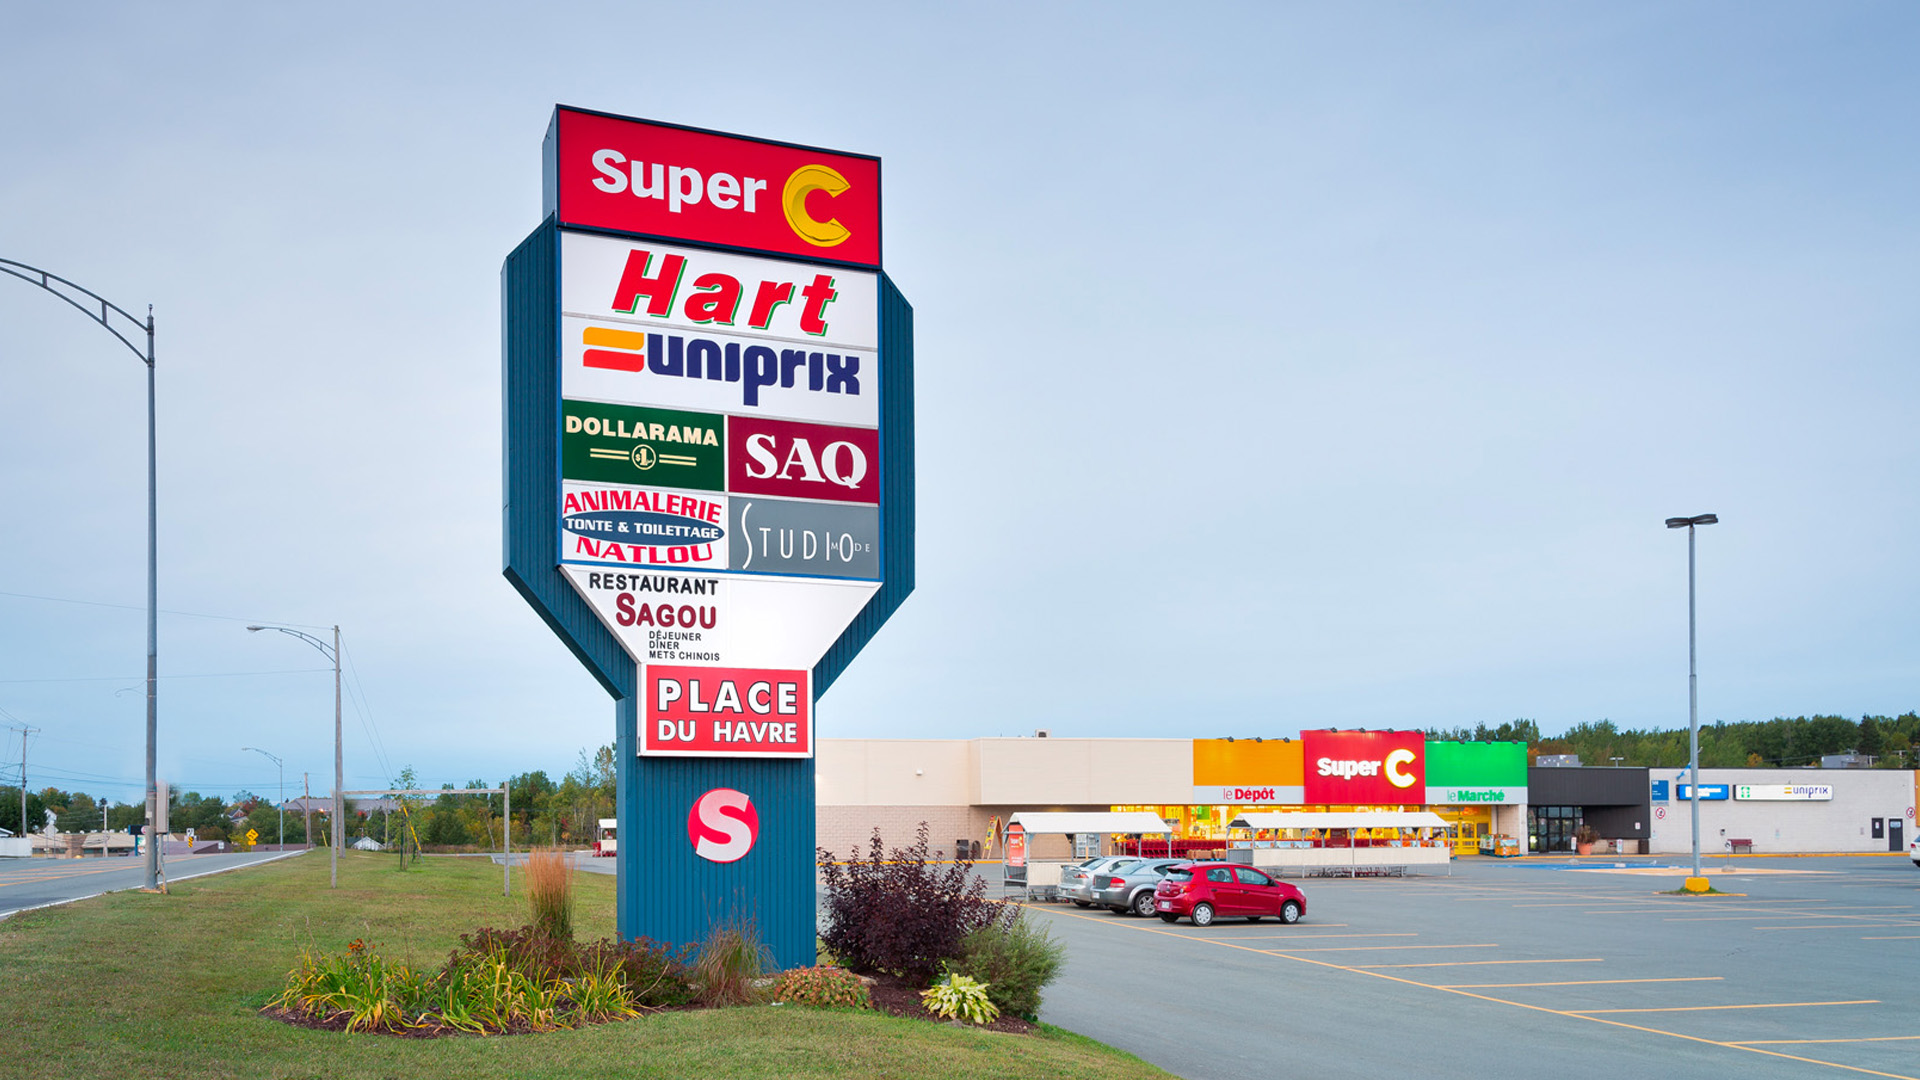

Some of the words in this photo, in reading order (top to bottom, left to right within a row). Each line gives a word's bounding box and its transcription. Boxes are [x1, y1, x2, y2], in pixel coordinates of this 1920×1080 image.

[592, 149, 767, 213] Super
[782, 164, 852, 247] C
[611, 249, 838, 336] Hart
[648, 333, 860, 406] uniprix
[566, 415, 719, 447] DOLLARAMA
[745, 433, 867, 489] SAQ
[563, 490, 722, 523] ANIMALERIE
[565, 518, 613, 532] TONTE
[617, 521, 630, 533] &
[633, 522, 719, 539] TOILETTAGE
[576, 536, 713, 564] NATLOU
[589, 573, 719, 596] RESTAURANT
[616, 592, 716, 630] SAGOU
[649, 630, 702, 641] DÉJEUNER
[649, 639, 680, 650] DÎNER
[649, 650, 676, 660] METS
[678, 651, 720, 661] CHINOIS
[657, 678, 798, 715] PLACE
[657, 719, 696, 742] DU
[713, 720, 798, 744] HAVRE
[1316, 757, 1382, 780] Super
[1383, 748, 1417, 788] C
[1223, 788, 1233, 800] le
[1234, 787, 1275, 802] Dépôt
[1447, 789, 1456, 802] le
[1457, 789, 1505, 802] Marché
[1793, 787, 1829, 799] uniprix
